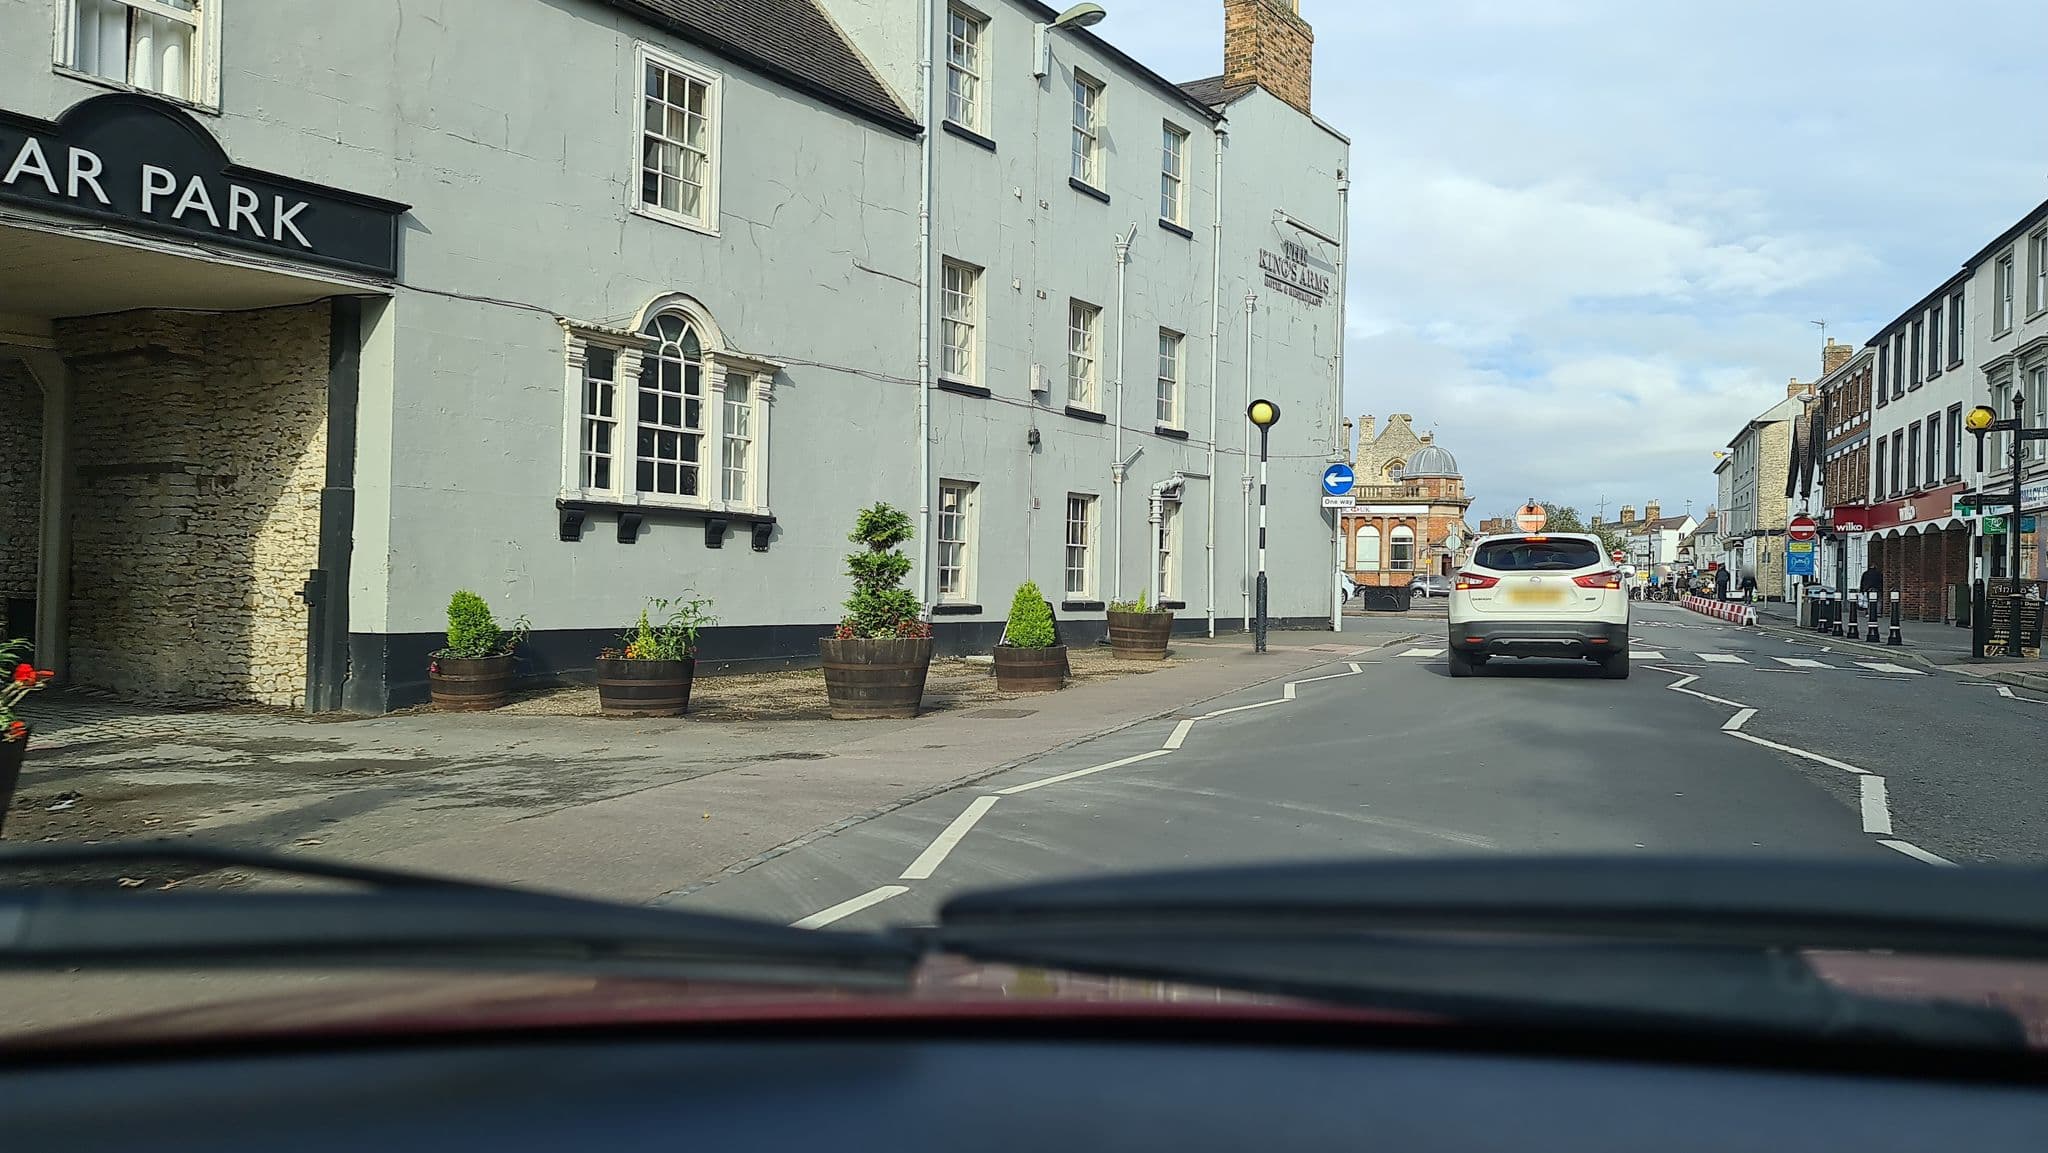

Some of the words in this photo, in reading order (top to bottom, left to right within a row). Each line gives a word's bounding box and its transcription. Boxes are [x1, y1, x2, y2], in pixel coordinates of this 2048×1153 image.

[3, 137, 111, 205] AR
[141, 163, 312, 248] PARK
[1259, 248, 1297, 282] KING'S
[1299, 268, 1329, 295] ARMS
[1284, 240, 1307, 267] THE
[1835, 521, 1863, 532] wilko
